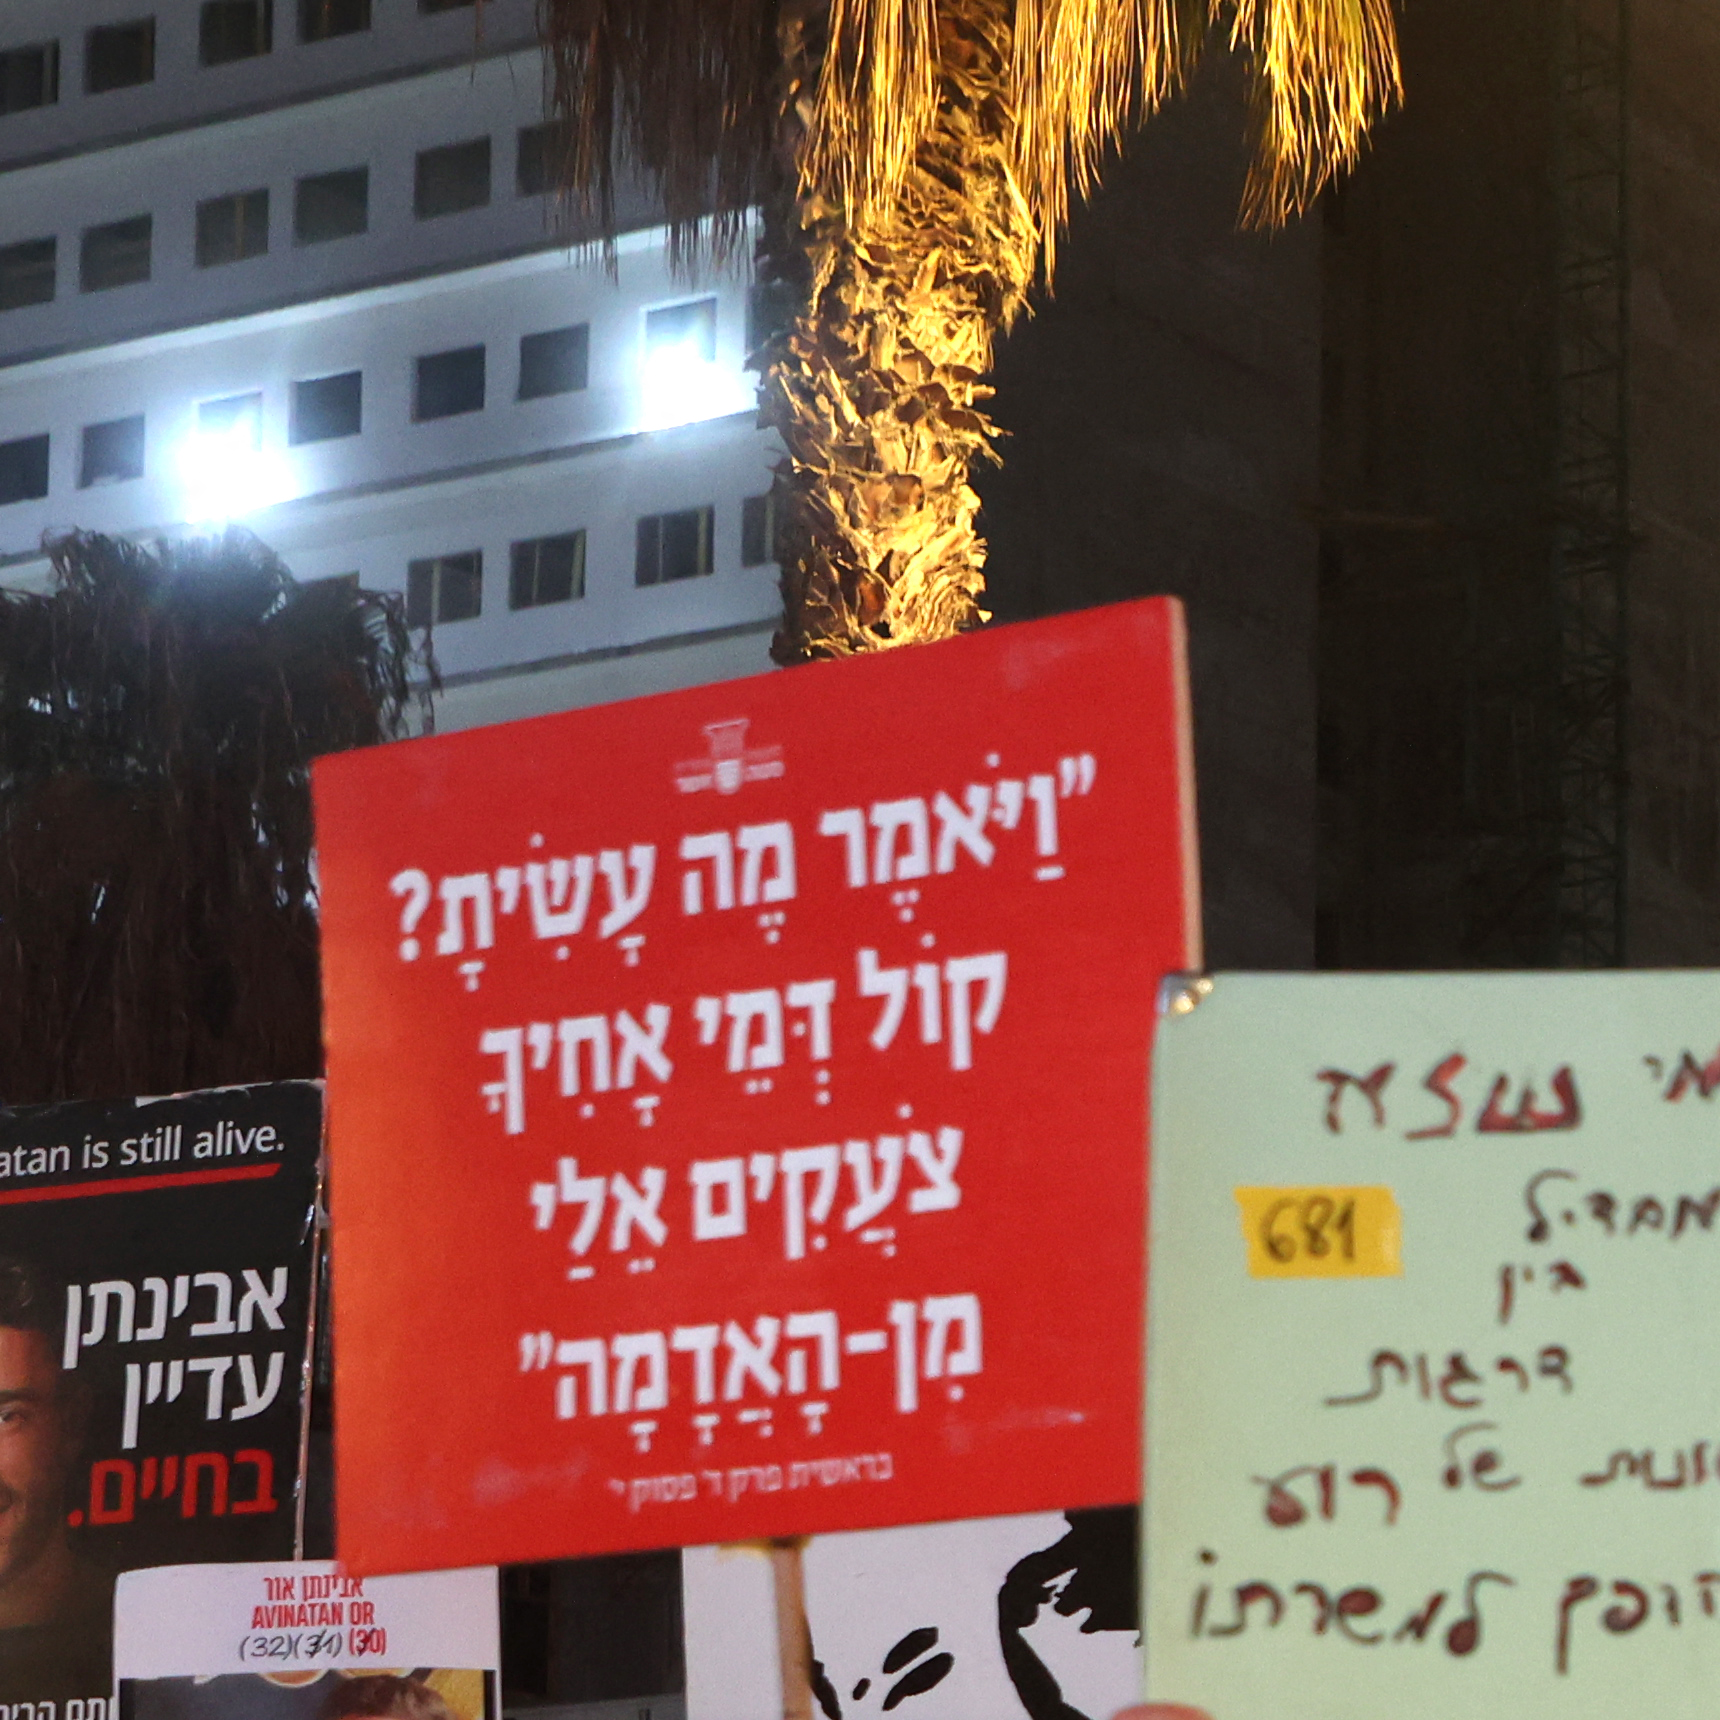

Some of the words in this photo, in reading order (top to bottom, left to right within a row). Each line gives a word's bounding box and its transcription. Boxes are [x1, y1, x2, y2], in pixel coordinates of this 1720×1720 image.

[82, 1134, 110, 1169] is
[119, 1124, 183, 1166] still
[193, 1120, 286, 1159] alive.
[1260, 1196, 1358, 1266] 681
[63, 1266, 289, 1369] אבינתן
[121, 1351, 286, 1449] עדיין
[1325, 1344, 1574, 1410] דרגות
[67, 1448, 279, 1528] בחיים.
[1443, 1420, 1522, 1494] של
[1250, 1465, 1402, 1530] רוע
[252, 1601, 344, 1630] AVINATAN
[349, 1601, 376, 1626] OR
[264, 1576, 295, 1601] אור
